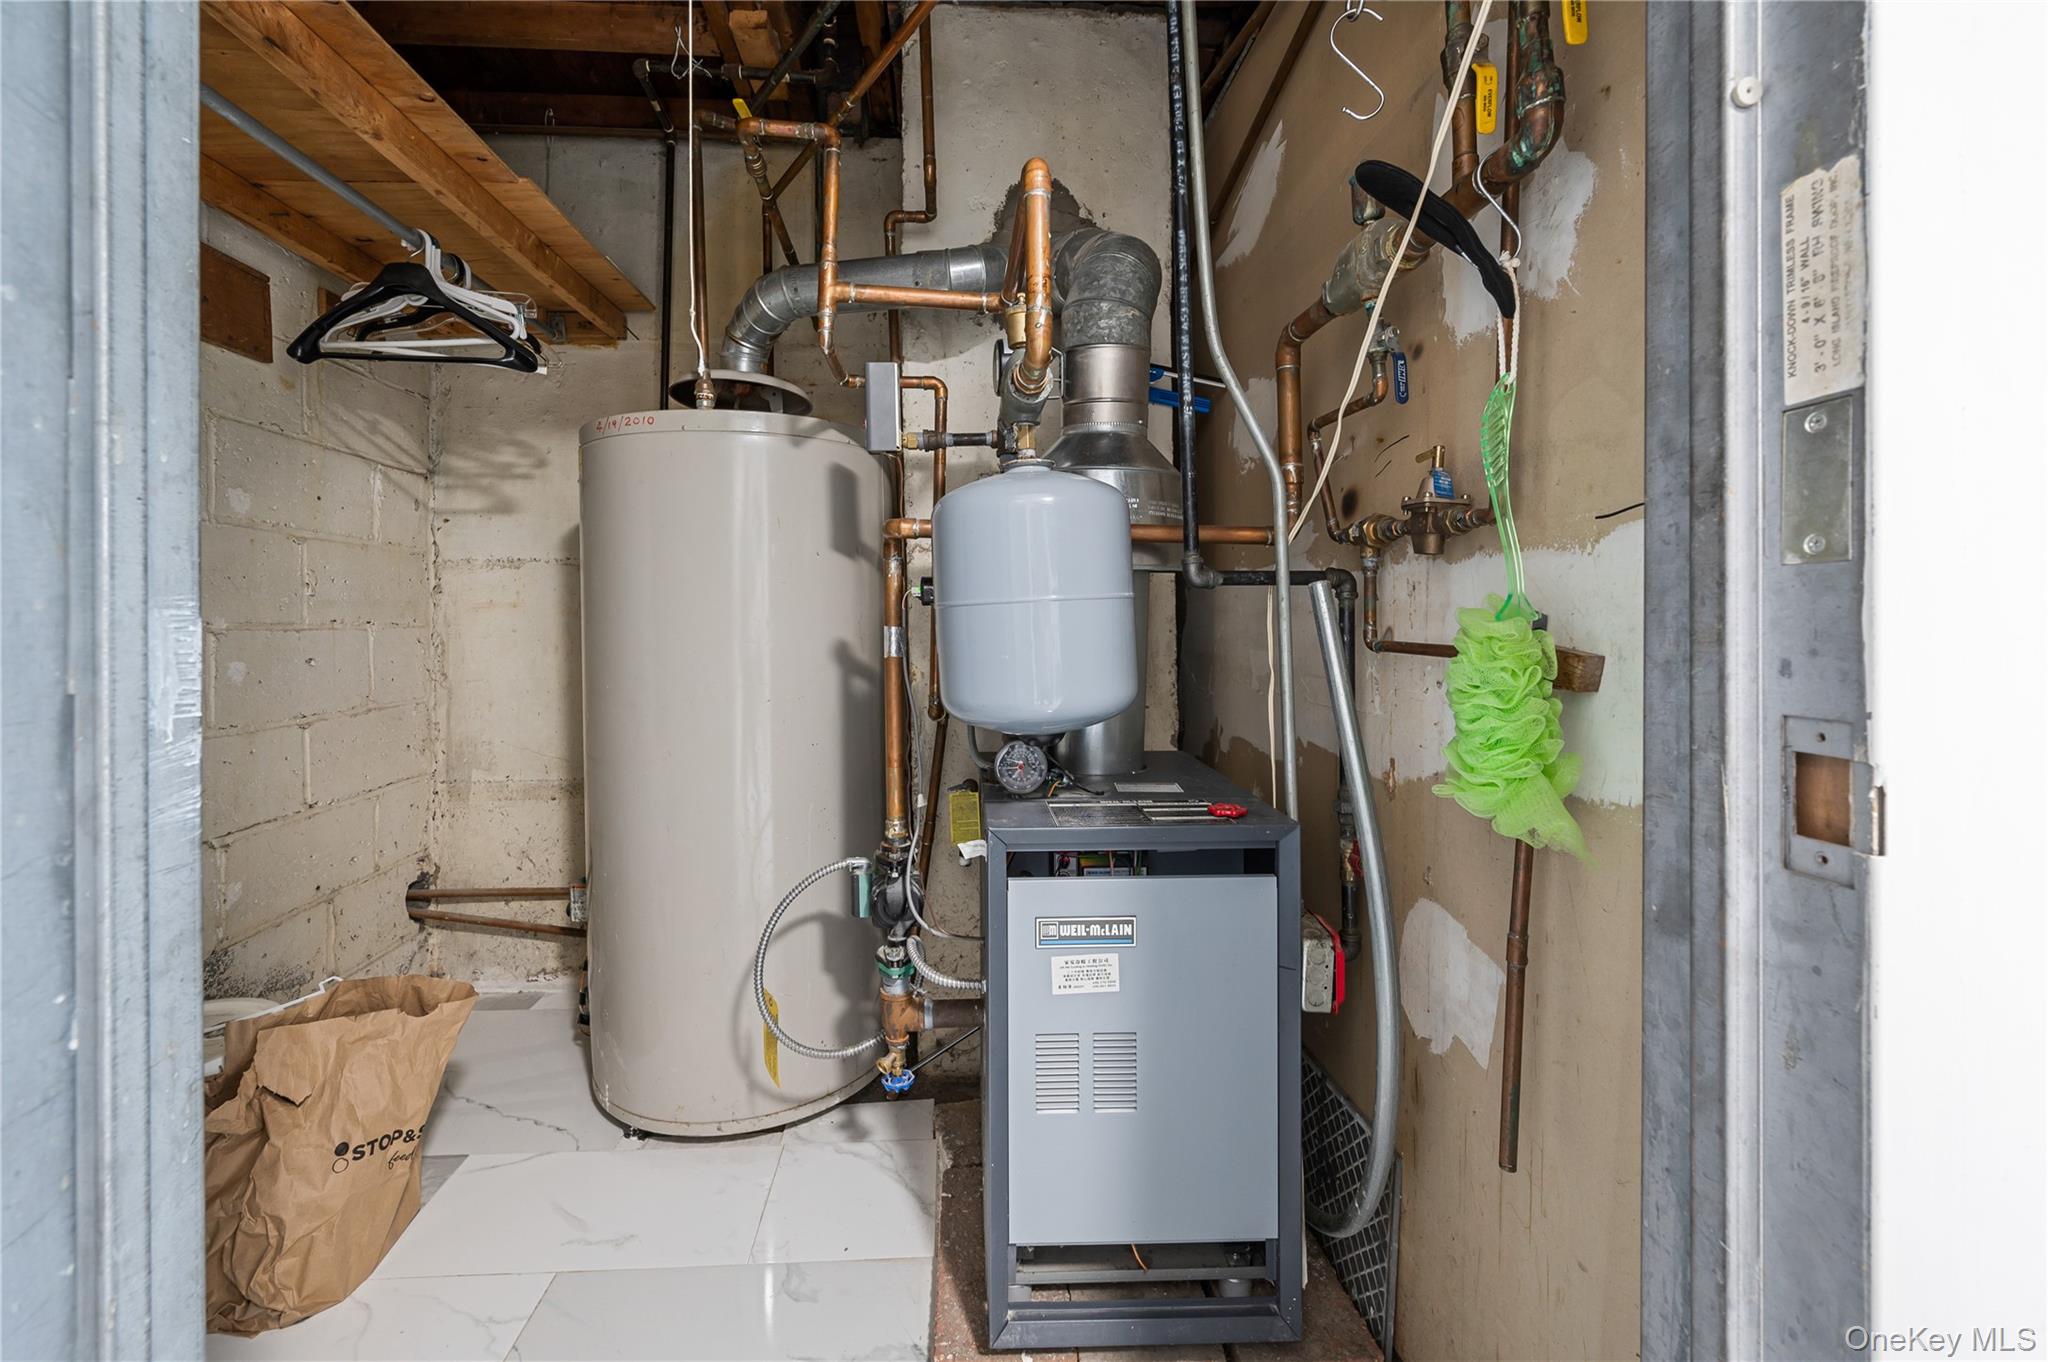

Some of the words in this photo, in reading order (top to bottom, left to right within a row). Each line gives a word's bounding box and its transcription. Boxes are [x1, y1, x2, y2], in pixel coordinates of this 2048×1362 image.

[1170, 36, 1179, 62] USA
[1785, 194, 1796, 235] FRAME
[1785, 238, 1796, 295] TRIMLESS
[1800, 236, 1810, 272] WALL
[1785, 300, 1797, 379] KNOCK-DOWN
[1831, 337, 1841, 368] LONG
